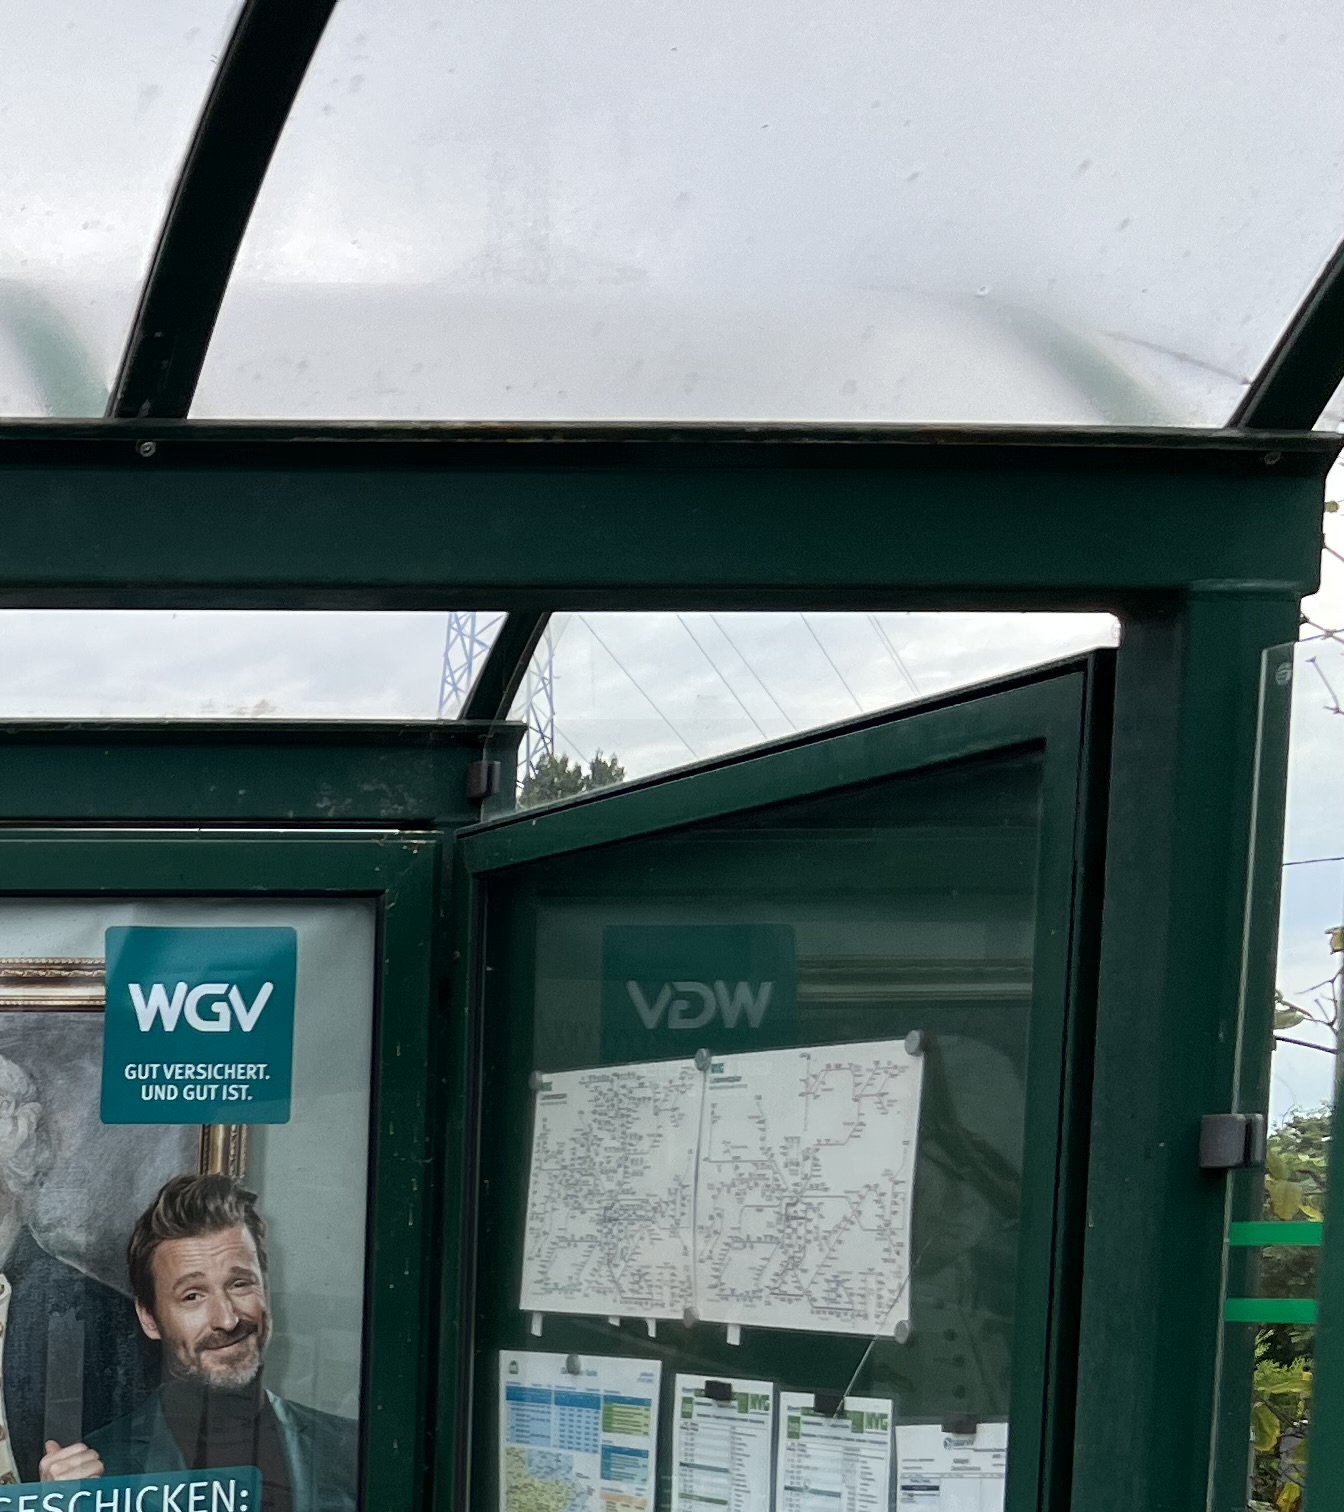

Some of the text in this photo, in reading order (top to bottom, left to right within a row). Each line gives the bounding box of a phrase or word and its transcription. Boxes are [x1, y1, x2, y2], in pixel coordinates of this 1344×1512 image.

[127, 981, 274, 1032] WGV
[124, 1063, 271, 1080] GUT VERSICHERT.
[141, 1084, 253, 1101] UND GUT IST.
